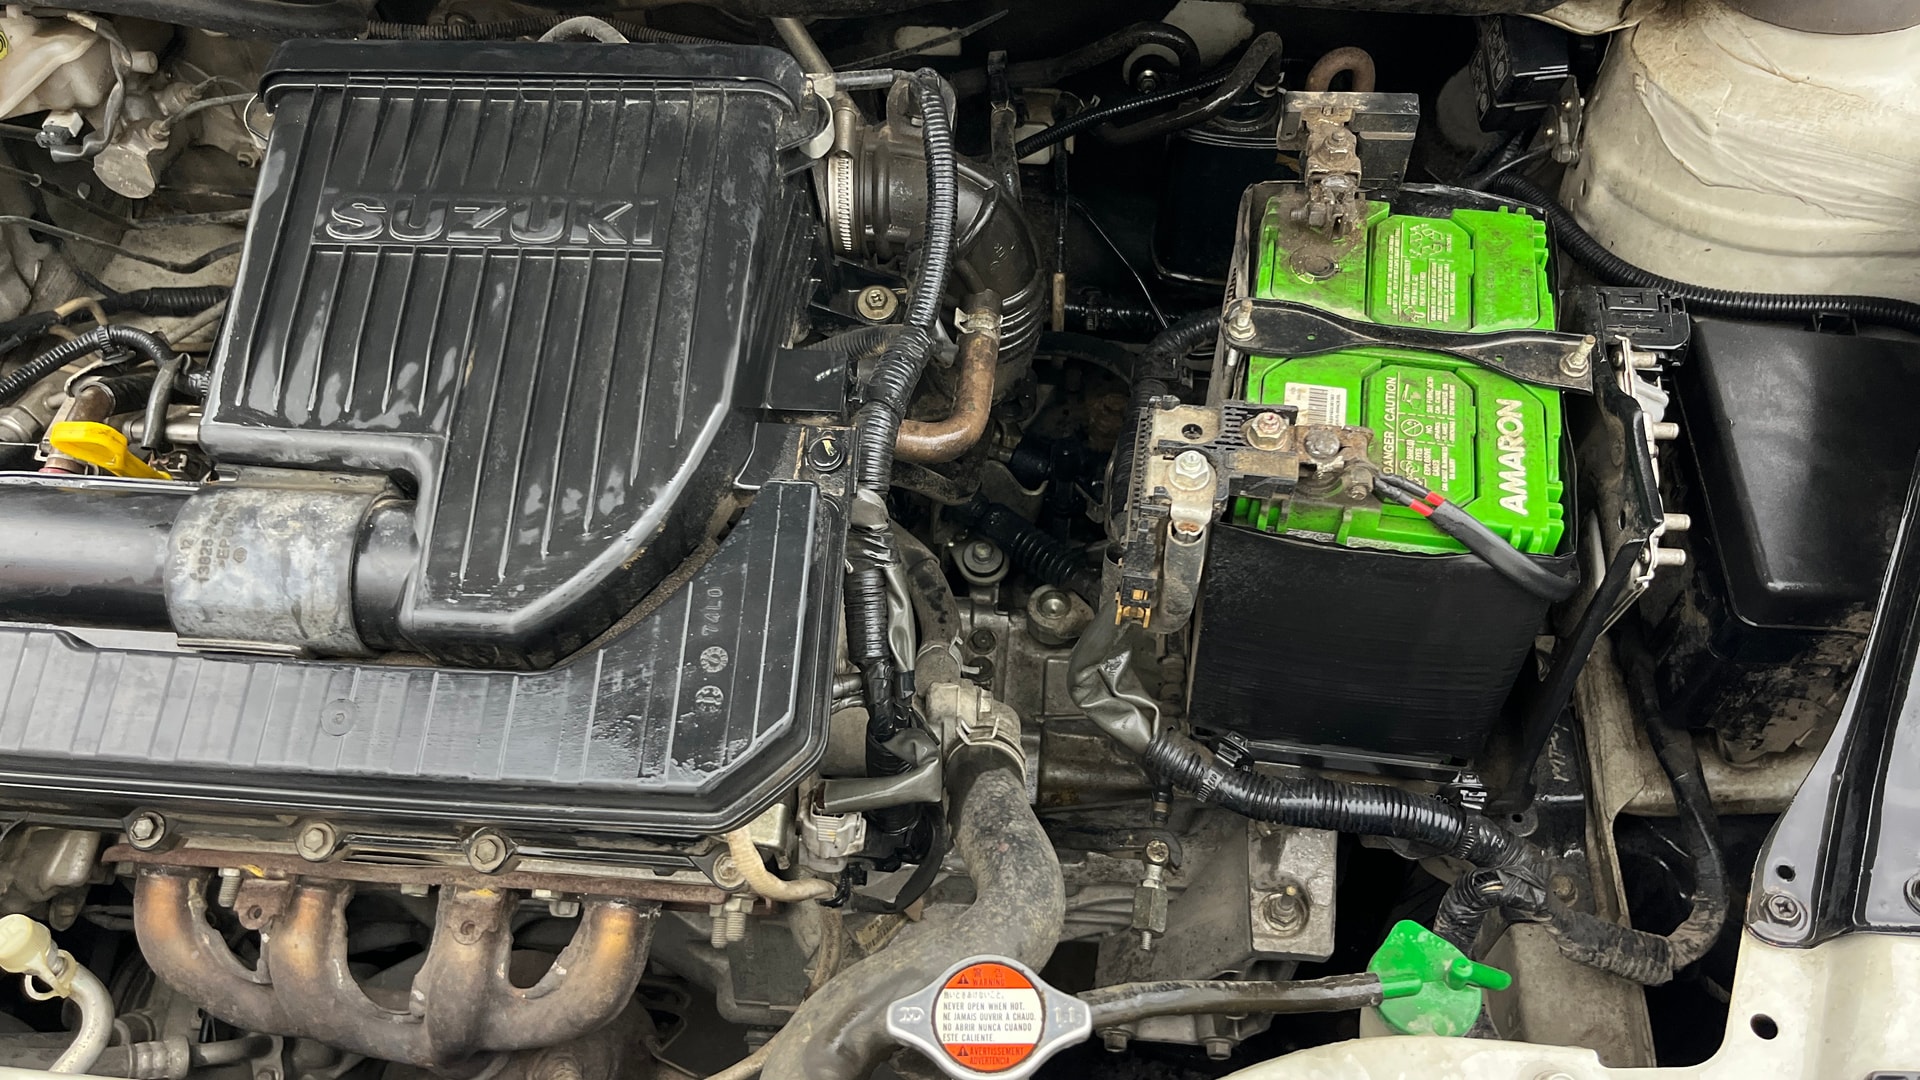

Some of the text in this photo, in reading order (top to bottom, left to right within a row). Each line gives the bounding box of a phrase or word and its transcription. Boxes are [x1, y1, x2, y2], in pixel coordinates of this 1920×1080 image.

[325, 198, 653, 244] SUZUKI
[1384, 377, 1397, 421] CAUTION
[1425, 425, 1433, 434] NO
[1382, 431, 1395, 474] DANGER
[1495, 398, 1529, 516] AMARON
[943, 1002, 1025, 1011] NEVER OPEN WHEN HOT.
[943, 1012, 950, 1021] NE
[954, 1012, 977, 1021] JAMAIS
[979, 1012, 1003, 1021] OUVRIR
[942, 1023, 1032, 1031] NO ABRIR NUNCA CUANDO
[969, 1047, 1024, 1056] AVERTISSEMENT
[969, 1056, 1010, 1065] ADVERTENCIA
